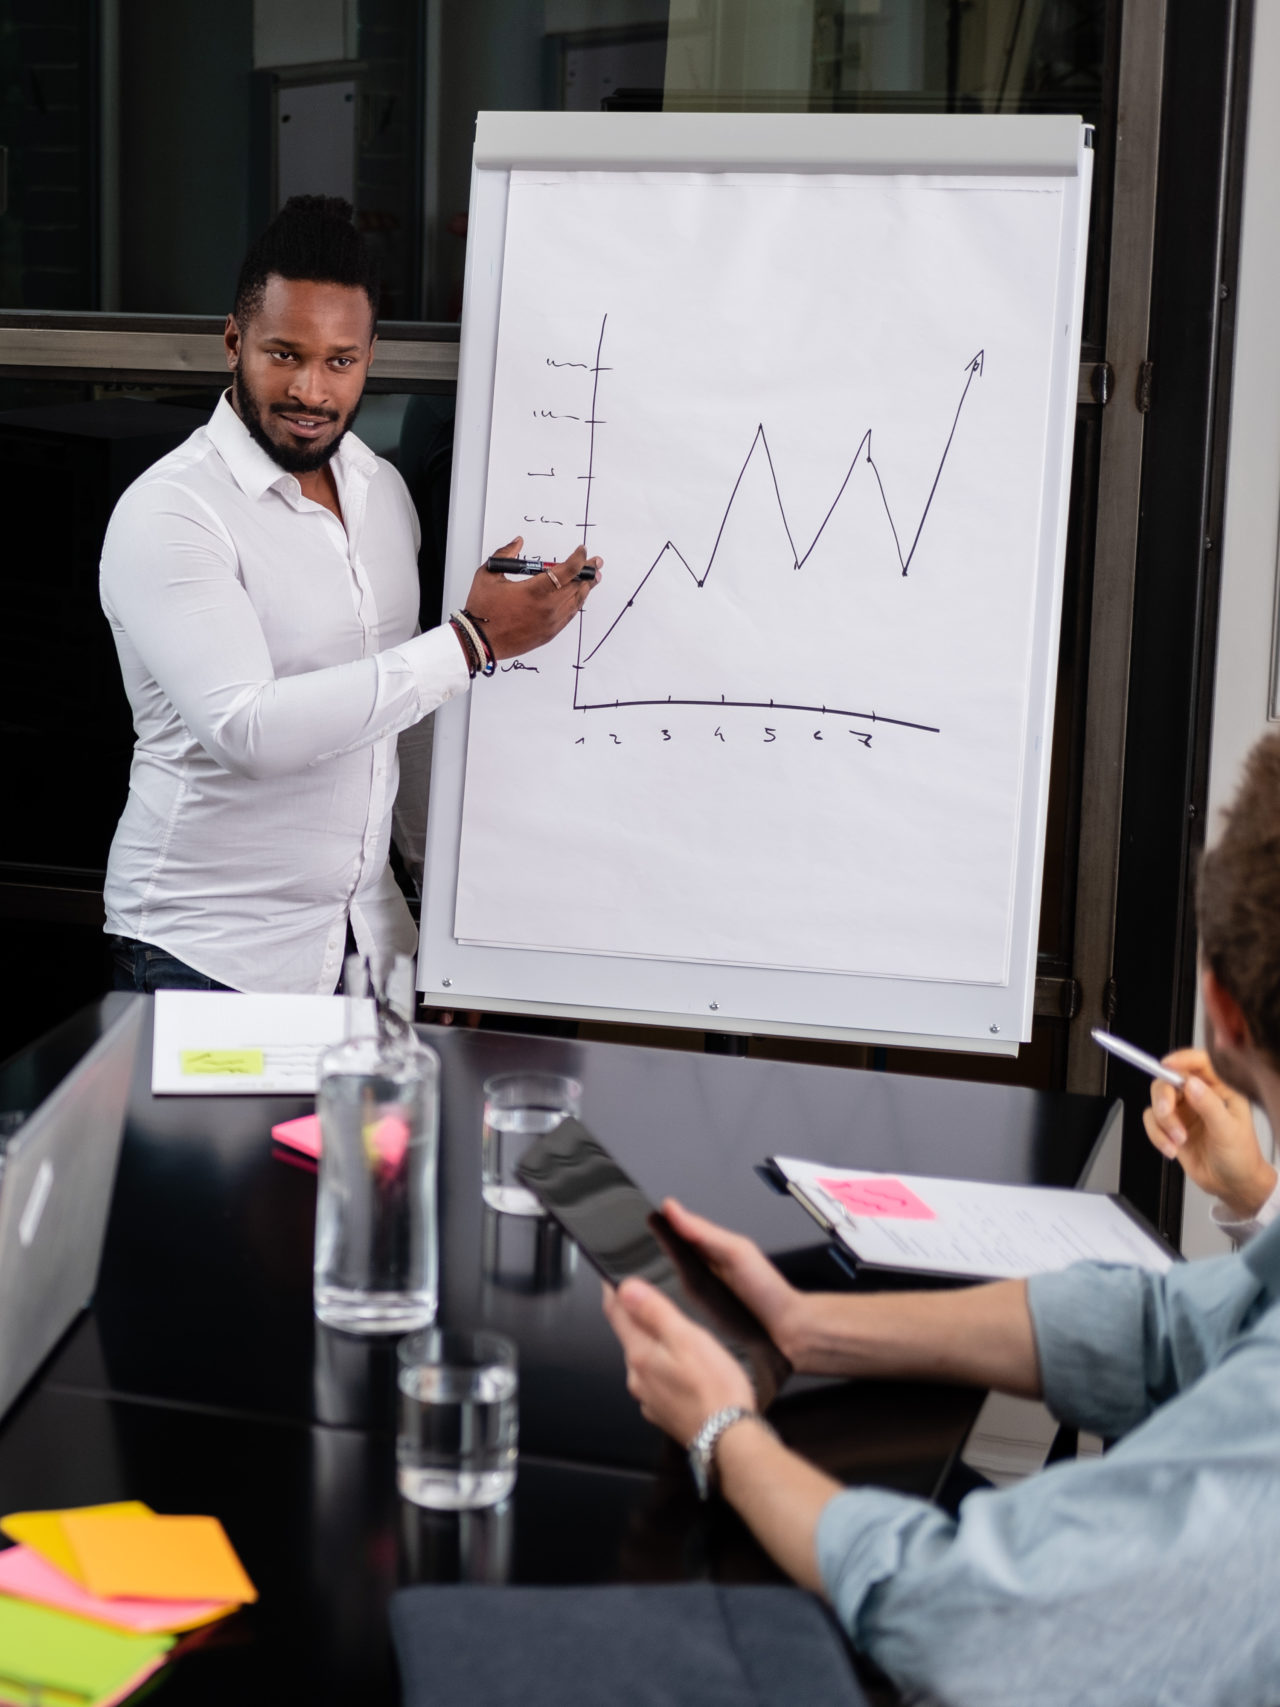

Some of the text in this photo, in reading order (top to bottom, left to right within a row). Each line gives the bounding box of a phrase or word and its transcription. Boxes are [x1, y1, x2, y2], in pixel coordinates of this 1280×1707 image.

[608, 733, 622, 745] 2
[660, 729, 672, 742] 3
[763, 727, 777, 743] 5
